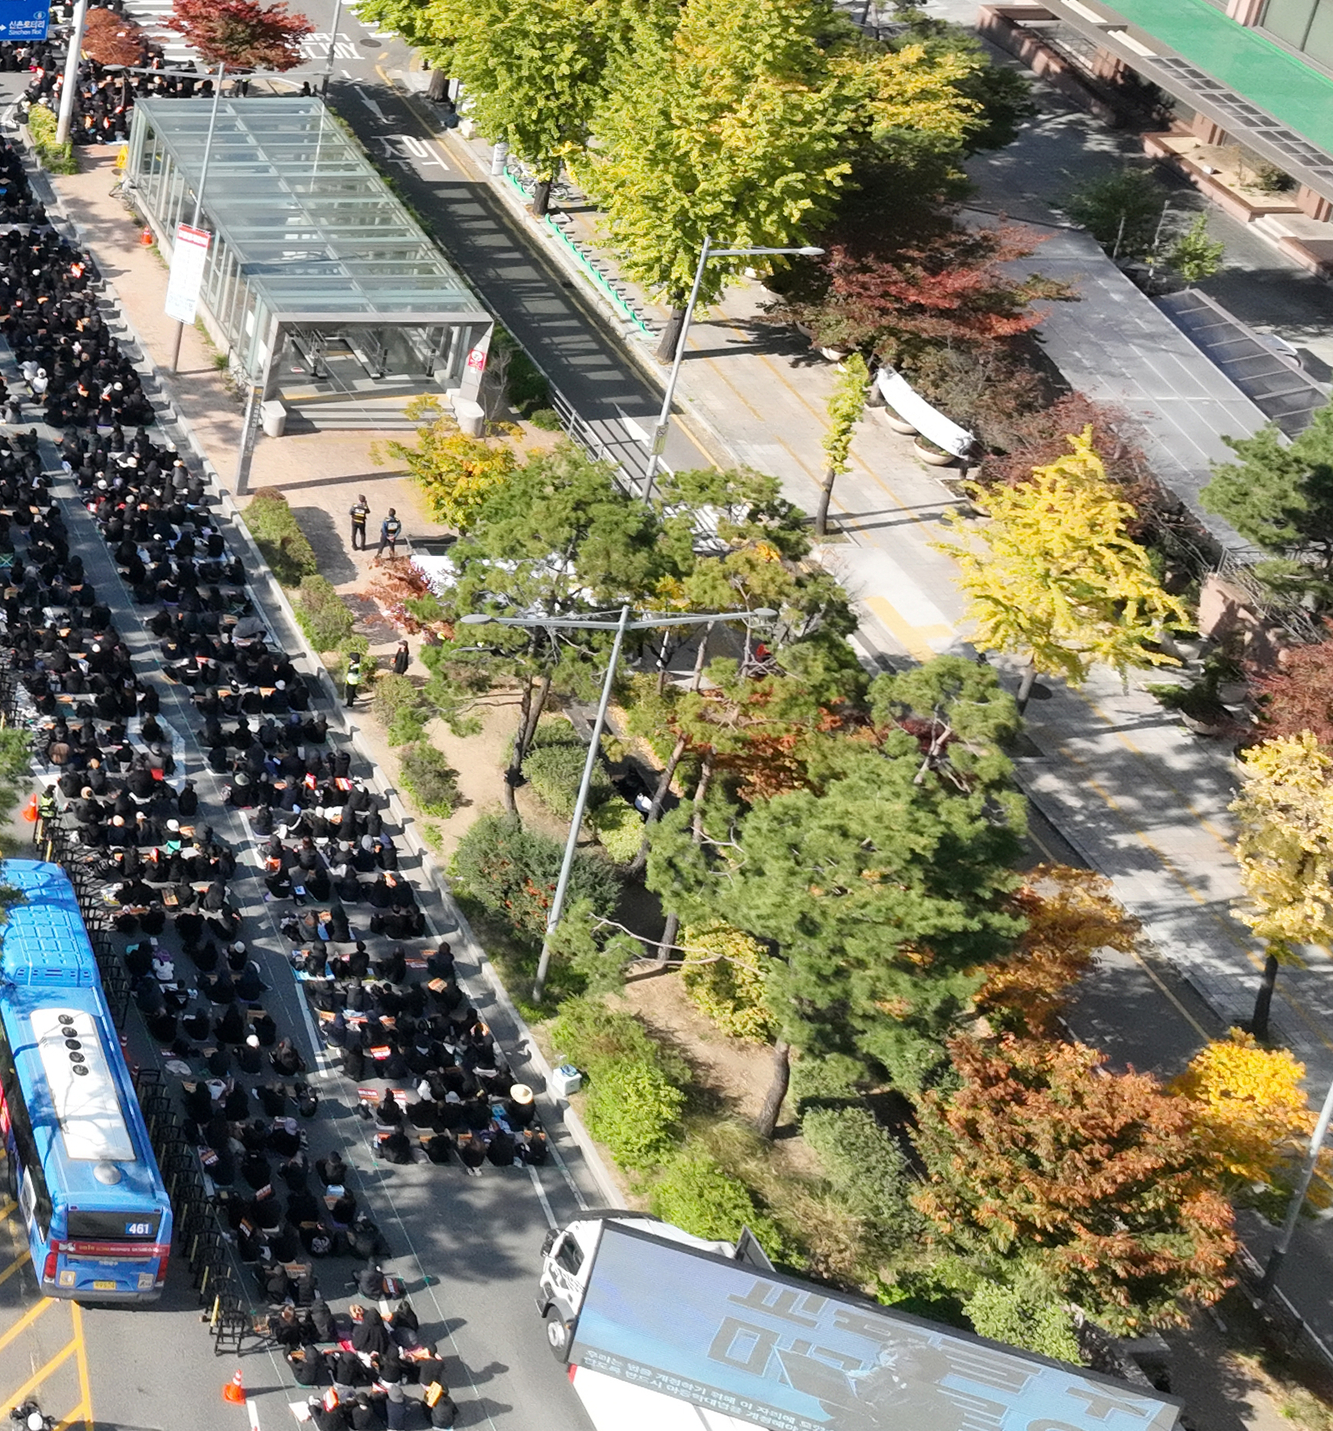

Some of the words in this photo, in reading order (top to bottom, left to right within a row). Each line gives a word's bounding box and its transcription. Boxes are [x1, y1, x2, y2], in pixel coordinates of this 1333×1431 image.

[8, 20, 45, 30] 신촌로터리
[128, 1223, 149, 1235] 461
[585, 1349, 624, 1367] 우리는
[627, 1362, 653, 1378] 법을
[656, 1371, 707, 1396] 개정하기
[710, 1389, 737, 1405] 위해
[740, 1399, 753, 1412] 이
[756, 1406, 796, 1425] 자리에
[625, 1370, 662, 1390] 반드시
[665, 1384, 743, 1415] 아동학대법을
